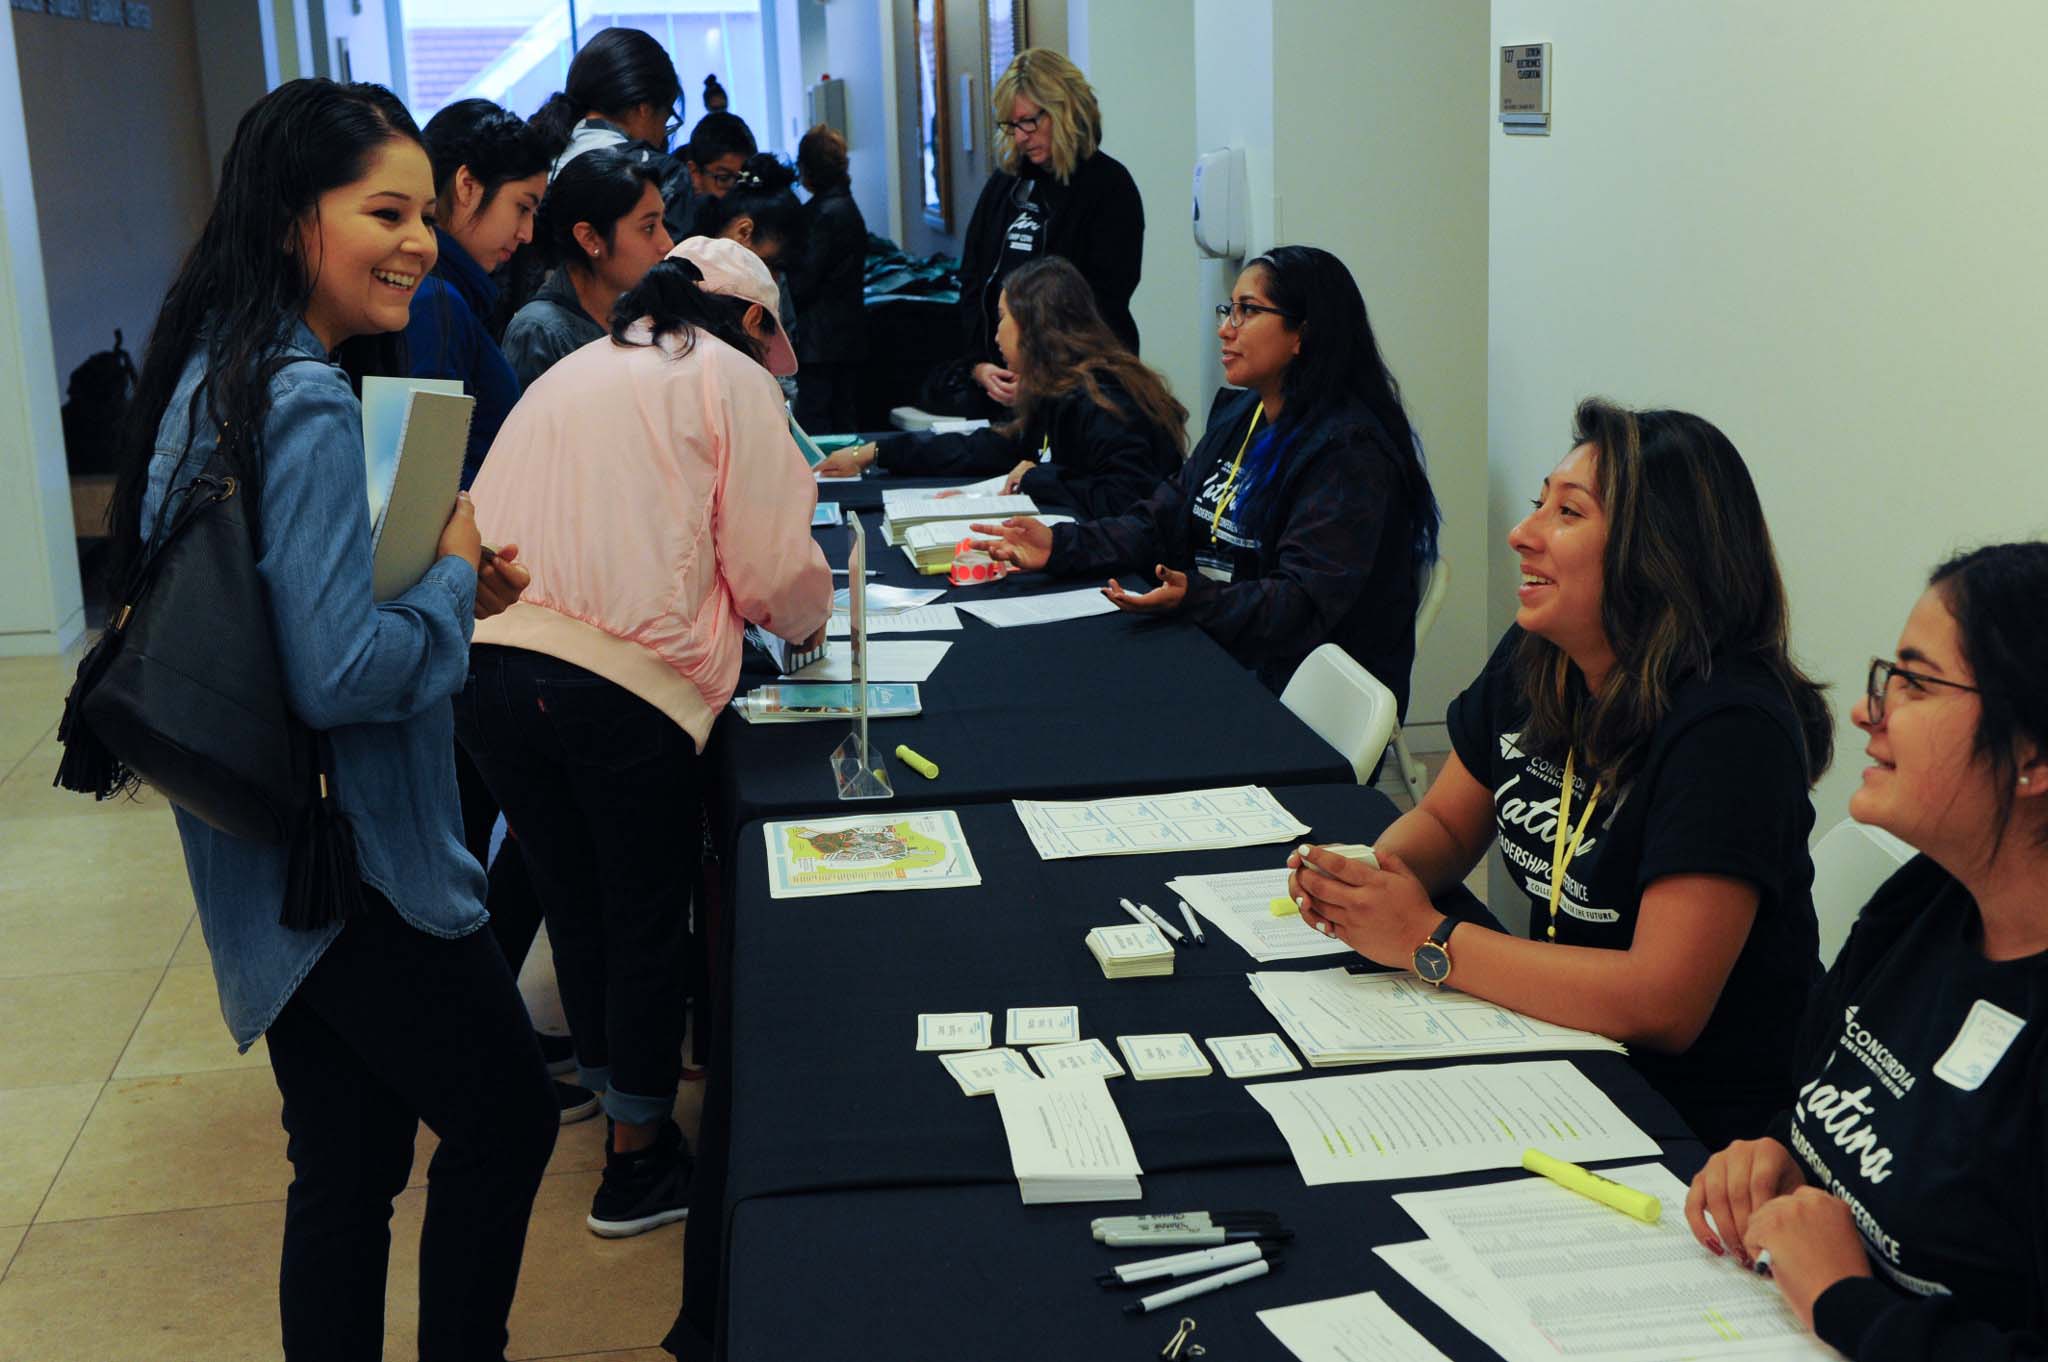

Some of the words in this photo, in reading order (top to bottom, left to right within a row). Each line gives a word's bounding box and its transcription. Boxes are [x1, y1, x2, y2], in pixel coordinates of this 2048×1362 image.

[1526, 765, 1563, 789] UNIVERSIT
[1586, 911, 1613, 920] FUTURE
[1846, 1022, 1916, 1092] CONCORDIA
